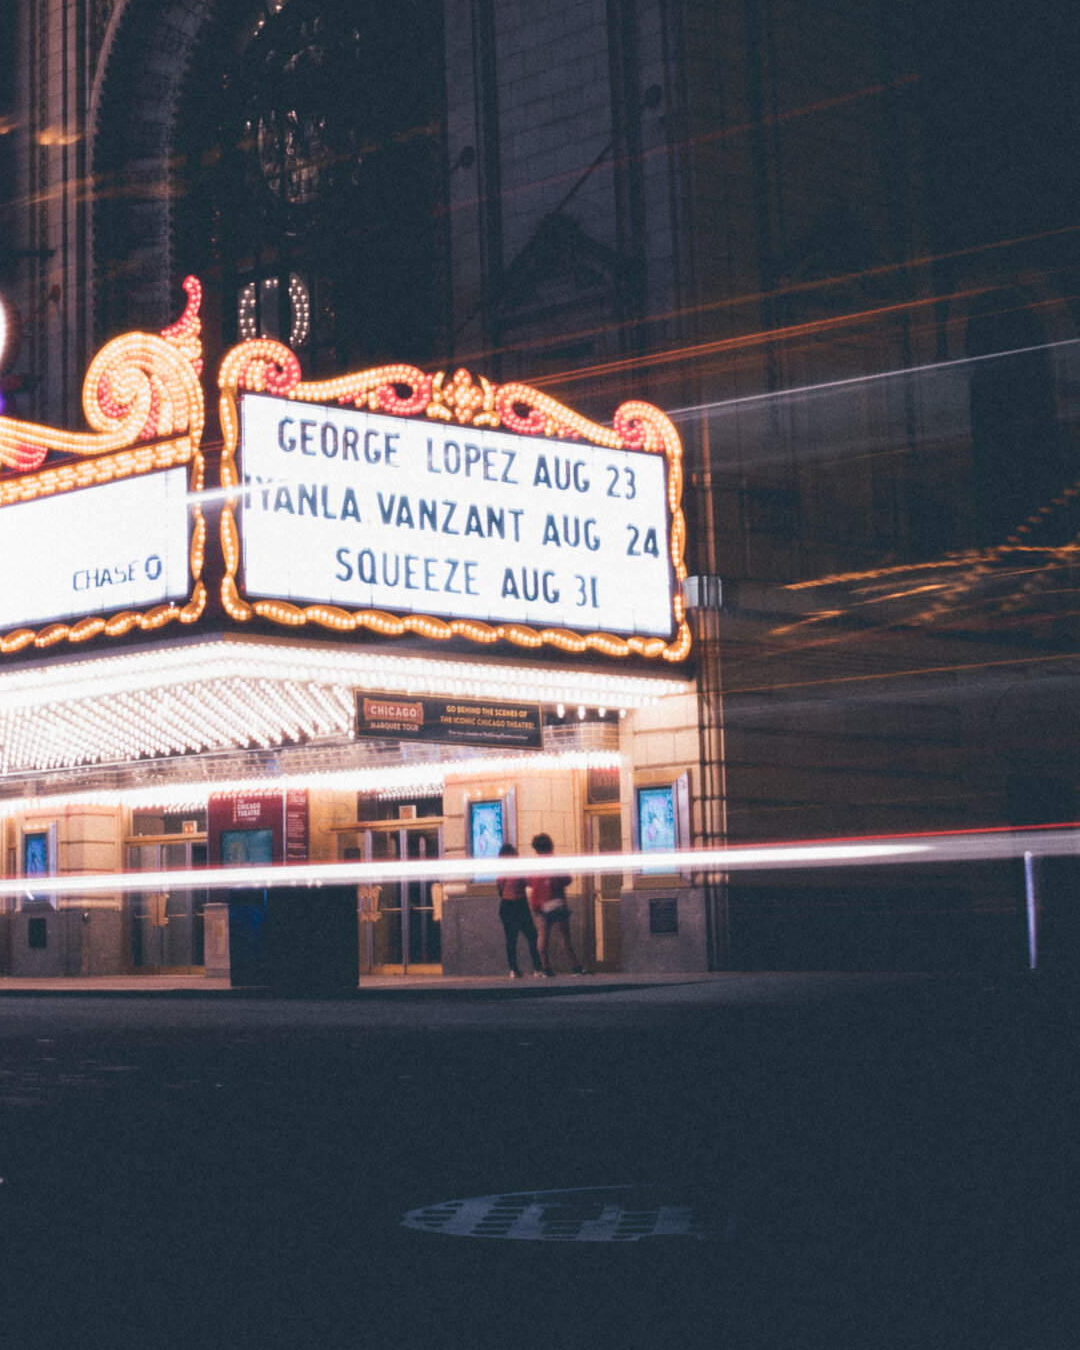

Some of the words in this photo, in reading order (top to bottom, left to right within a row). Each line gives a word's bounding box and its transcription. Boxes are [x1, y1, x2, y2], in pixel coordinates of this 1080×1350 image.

[277, 415, 400, 468] GEORGE
[427, 436, 518, 485] LOPEZ
[533, 454, 590, 494] AUG
[606, 463, 637, 500] 23
[245, 473, 361, 523] IYANLA
[377, 491, 525, 543] VANZANT
[542, 513, 601, 552] AUG
[626, 523, 660, 559] 24
[73, 559, 139, 591] CHASE
[336, 546, 480, 596] SQUEEZE
[501, 566, 560, 604] AUG
[575, 573, 600, 608] 31
[370, 705, 417, 718] CHICAGO
[446, 705, 456, 713] GO
[457, 705, 481, 715] BEHIND
[482, 707, 494, 716] THE
[495, 709, 518, 718] SCENES
[518, 710, 528, 719] OF
[402, 723, 419, 731] TOUR
[440, 715, 452, 723] THE
[453, 716, 476, 725] ICONIC
[477, 718, 506, 727] CHICAGO
[238, 809, 261, 817] THEATRE
